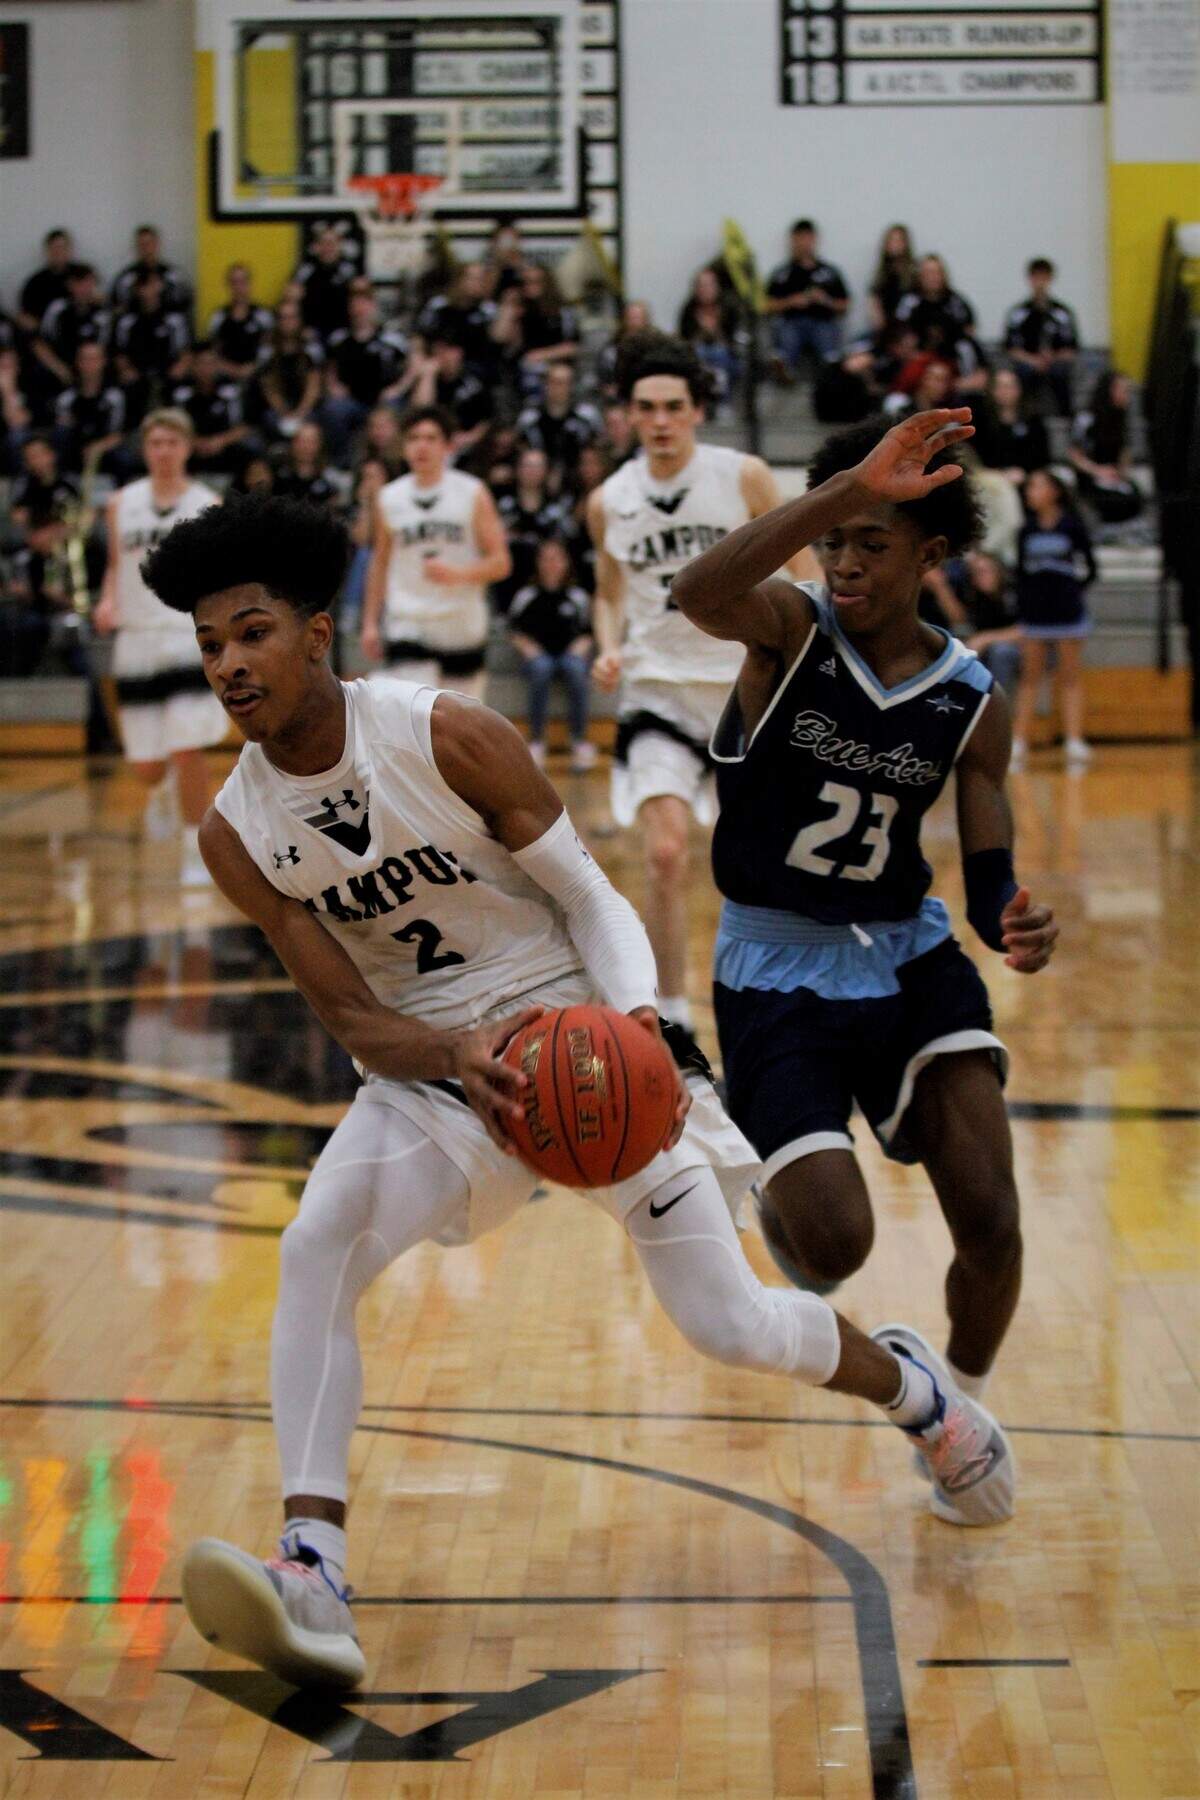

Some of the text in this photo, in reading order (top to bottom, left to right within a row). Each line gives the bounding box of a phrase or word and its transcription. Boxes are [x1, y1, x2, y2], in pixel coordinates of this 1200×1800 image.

[783, 15, 837, 58] 13
[789, 710, 870, 770] Blue
[784, 780, 899, 882] 23
[390, 918, 466, 975] 2
